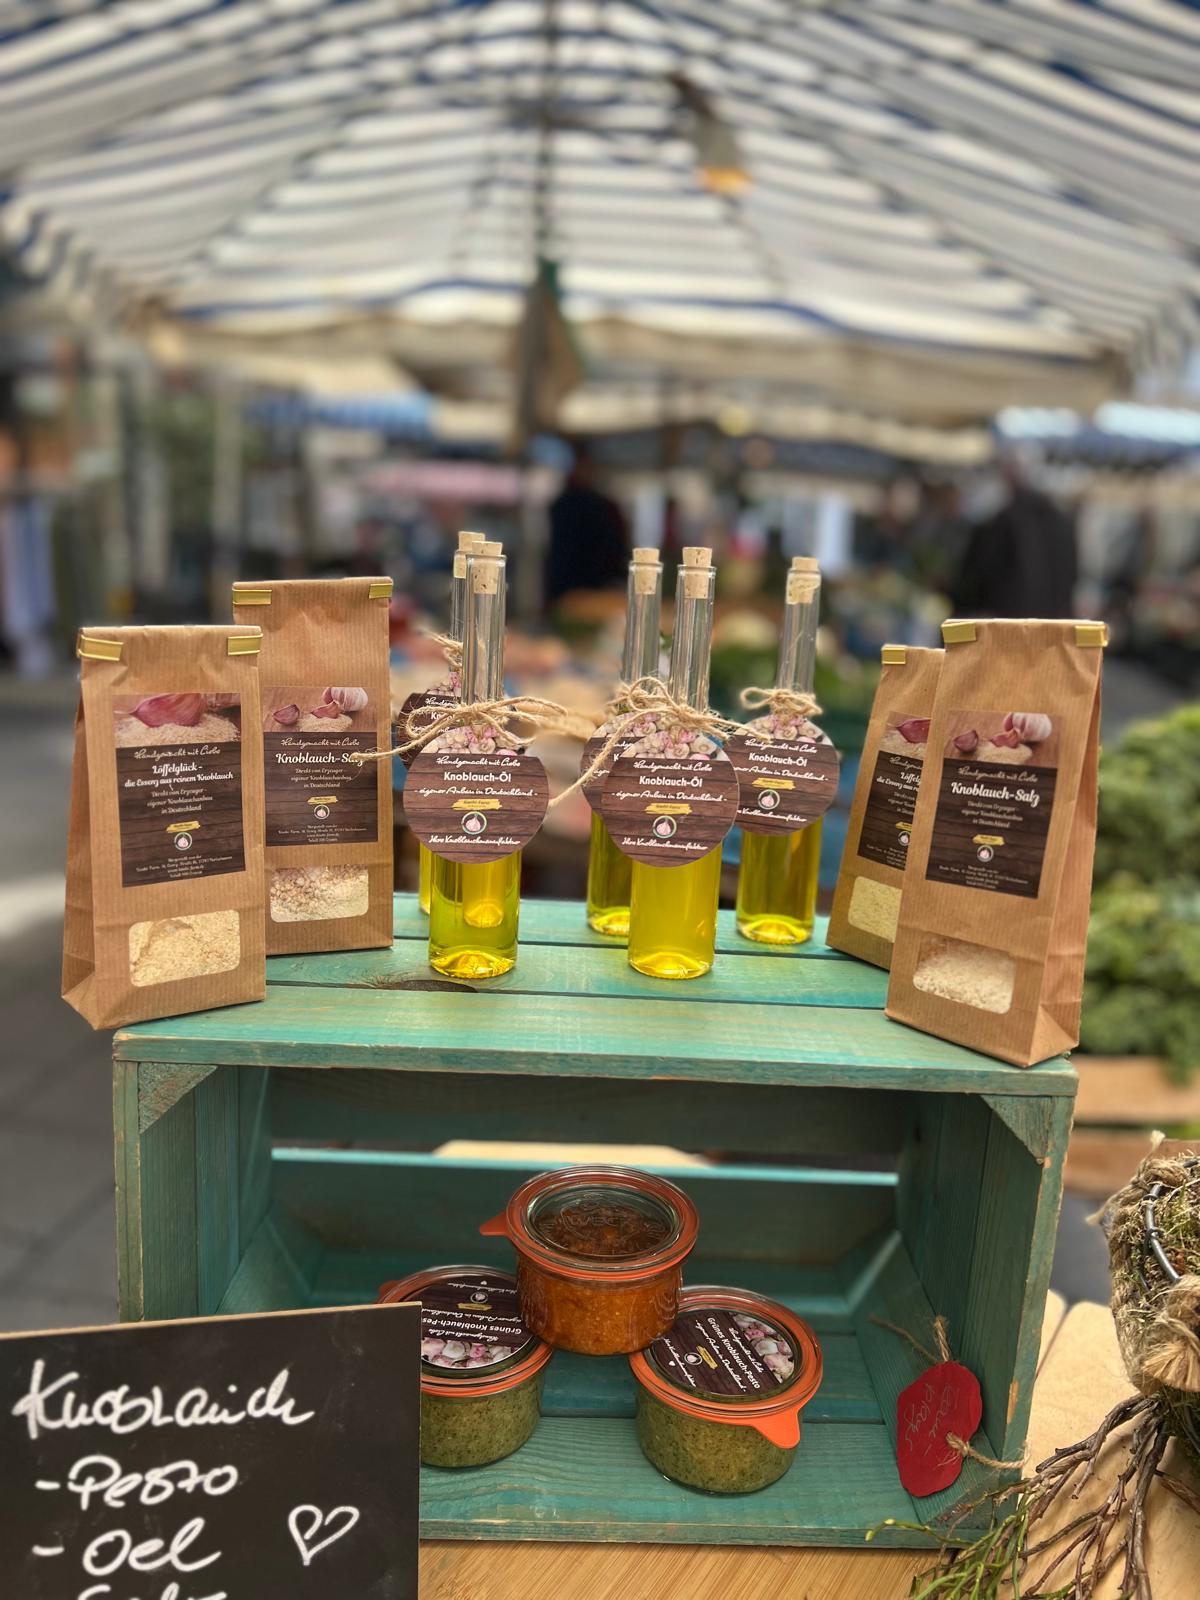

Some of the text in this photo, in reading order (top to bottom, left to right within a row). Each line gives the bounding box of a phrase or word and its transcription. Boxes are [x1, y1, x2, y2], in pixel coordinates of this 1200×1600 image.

[281, 738, 329, 750] Handgemacht
[341, 737, 359, 746] Liebe
[134, 745, 220, 762] Handgemacht mit Liebe
[749, 753, 807, 767] Knoblauch-Öl
[436, 756, 488, 768] Handgemacht
[500, 759, 521, 767] Liebe
[633, 760, 681, 772] Handgemacht
[693, 763, 712, 772] Liebe
[125, 771, 233, 789] die Essenz aus reinem Knoblauch
[444, 771, 511, 782] Knoblauch-Öl
[639, 775, 703, 787] Knoblauch-Öl
[419, 788, 446, 797] eigener
[446, 786, 475, 796] Anbau
[485, 787, 533, 797] Deutschland
[616, 792, 640, 800] eigener
[640, 790, 667, 799] Anbau
[676, 792, 723, 802] Deutschland
[951, 782, 1040, 808] Knoblauch-Salz
[422, 1317, 522, 1334] Grünes Knoblauch-Pes
[707, 1317, 725, 1340] Grünes
[721, 1338, 760, 1389] Knoblauch-Pesto
[67, 1454, 239, 1511] Pesto
[82, 1517, 222, 1577] Oel
